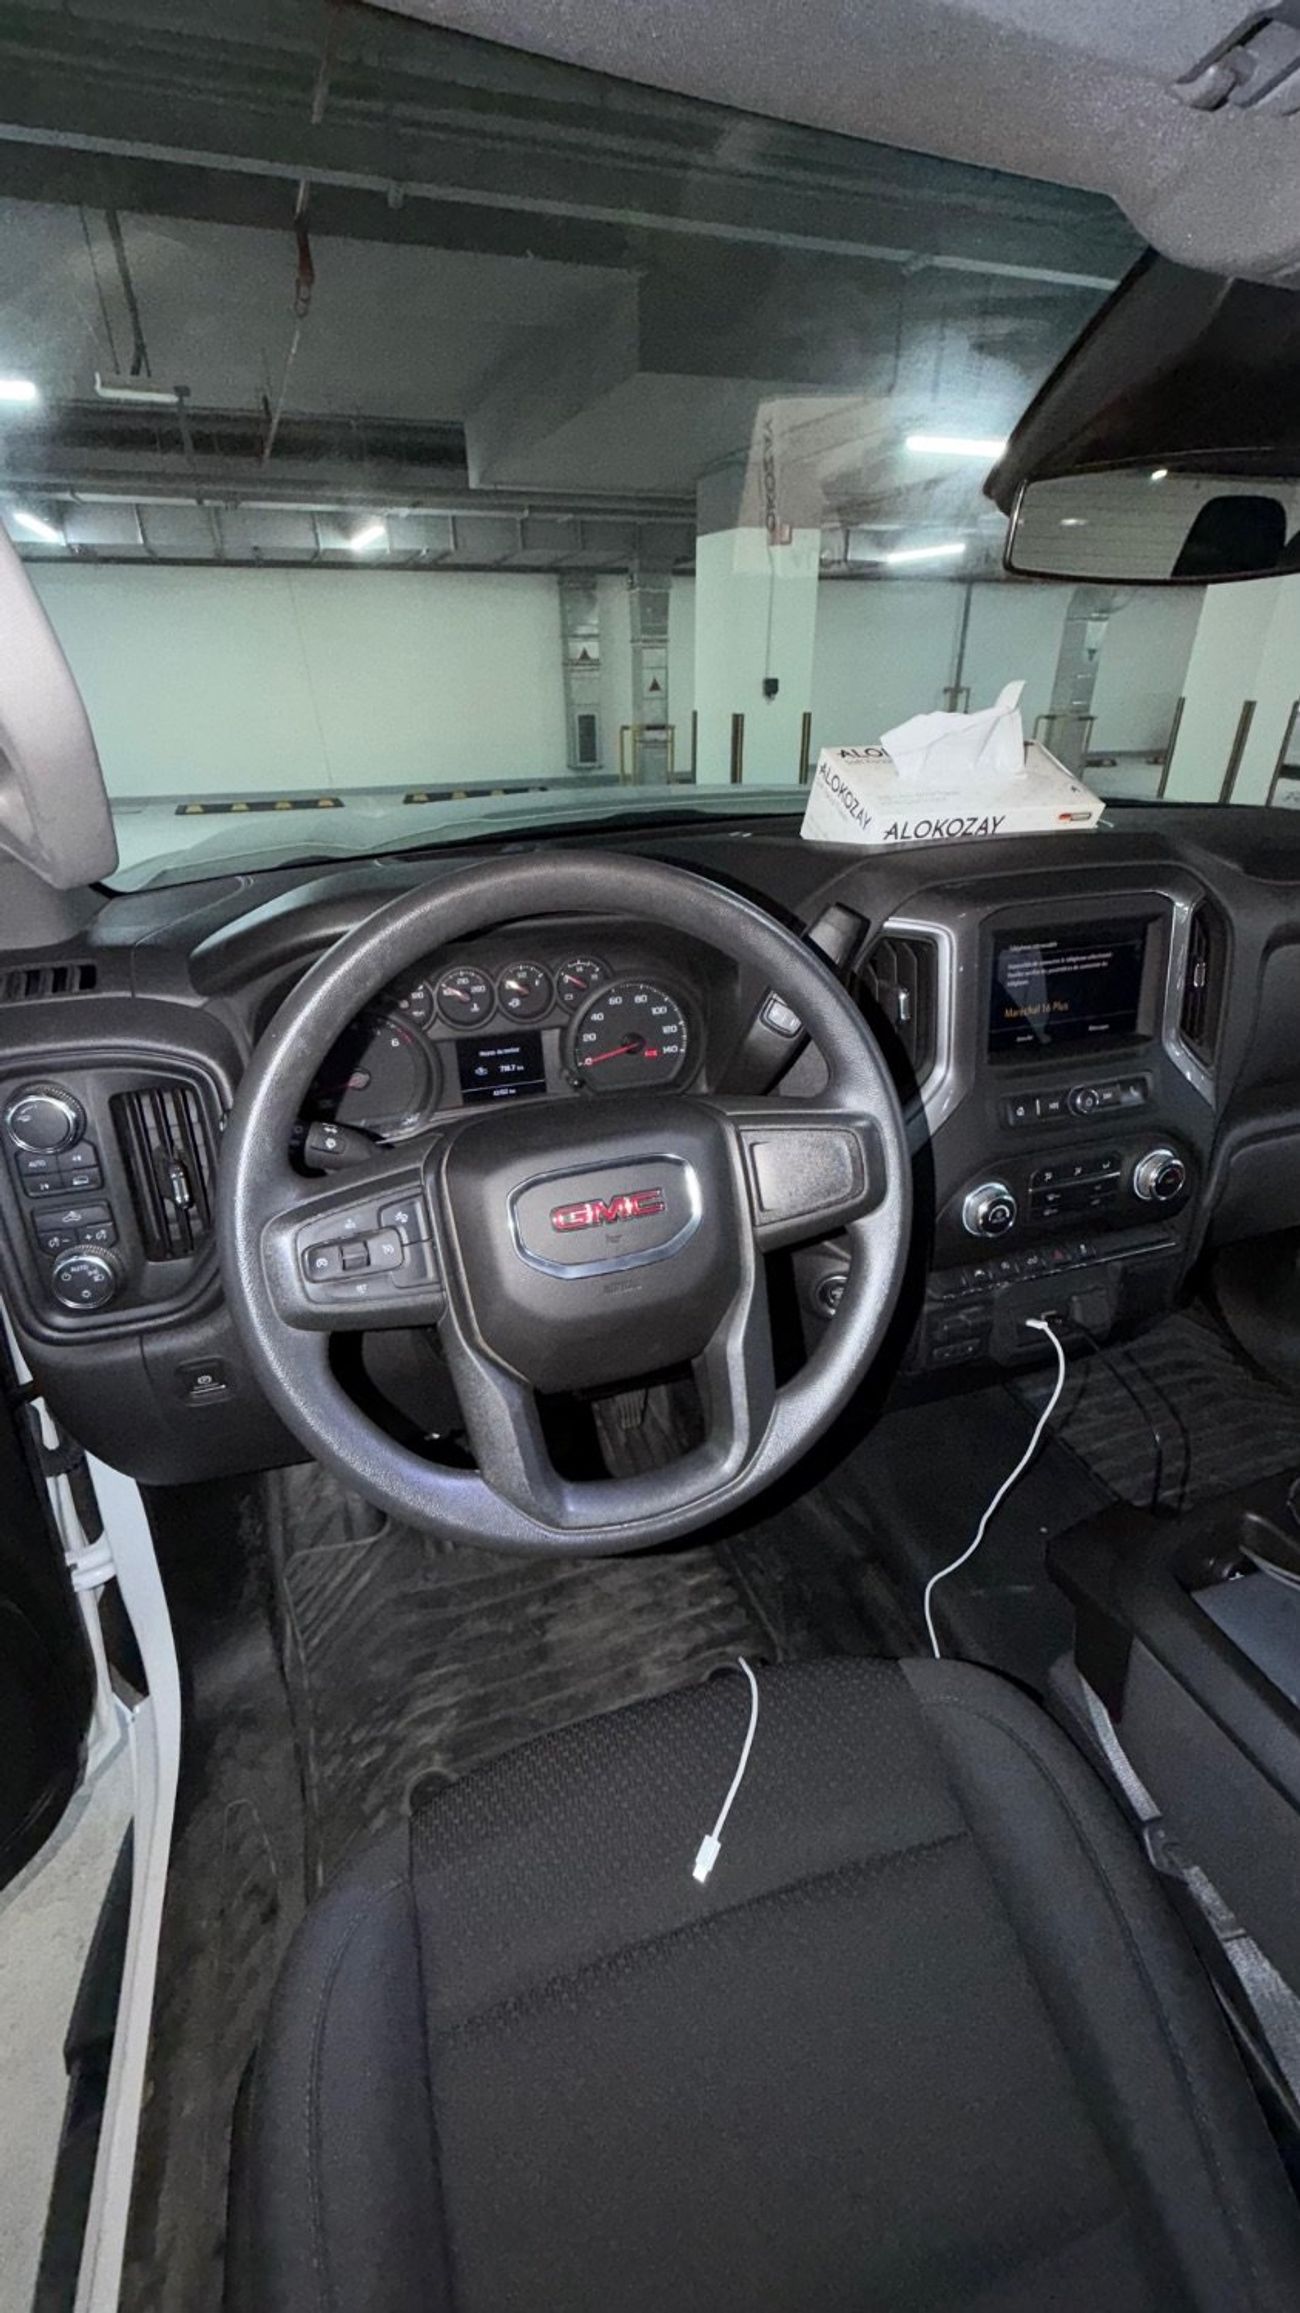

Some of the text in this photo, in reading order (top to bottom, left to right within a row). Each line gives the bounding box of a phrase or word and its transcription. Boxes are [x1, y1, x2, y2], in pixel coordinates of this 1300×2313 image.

[818, 762, 872, 830] ALOKOZAY
[883, 815, 1006, 841] ALOKOZAY
[608, 996, 622, 1005] 60
[634, 995, 648, 1004] 80
[651, 1006, 668, 1015] 100
[590, 1012, 604, 1021] 40
[662, 1024, 678, 1034] 120
[582, 1032, 597, 1042] 20
[662, 1045, 678, 1054] 140
[551, 1187, 666, 1232] GMC
[70, 1264, 89, 1273] AUTO
